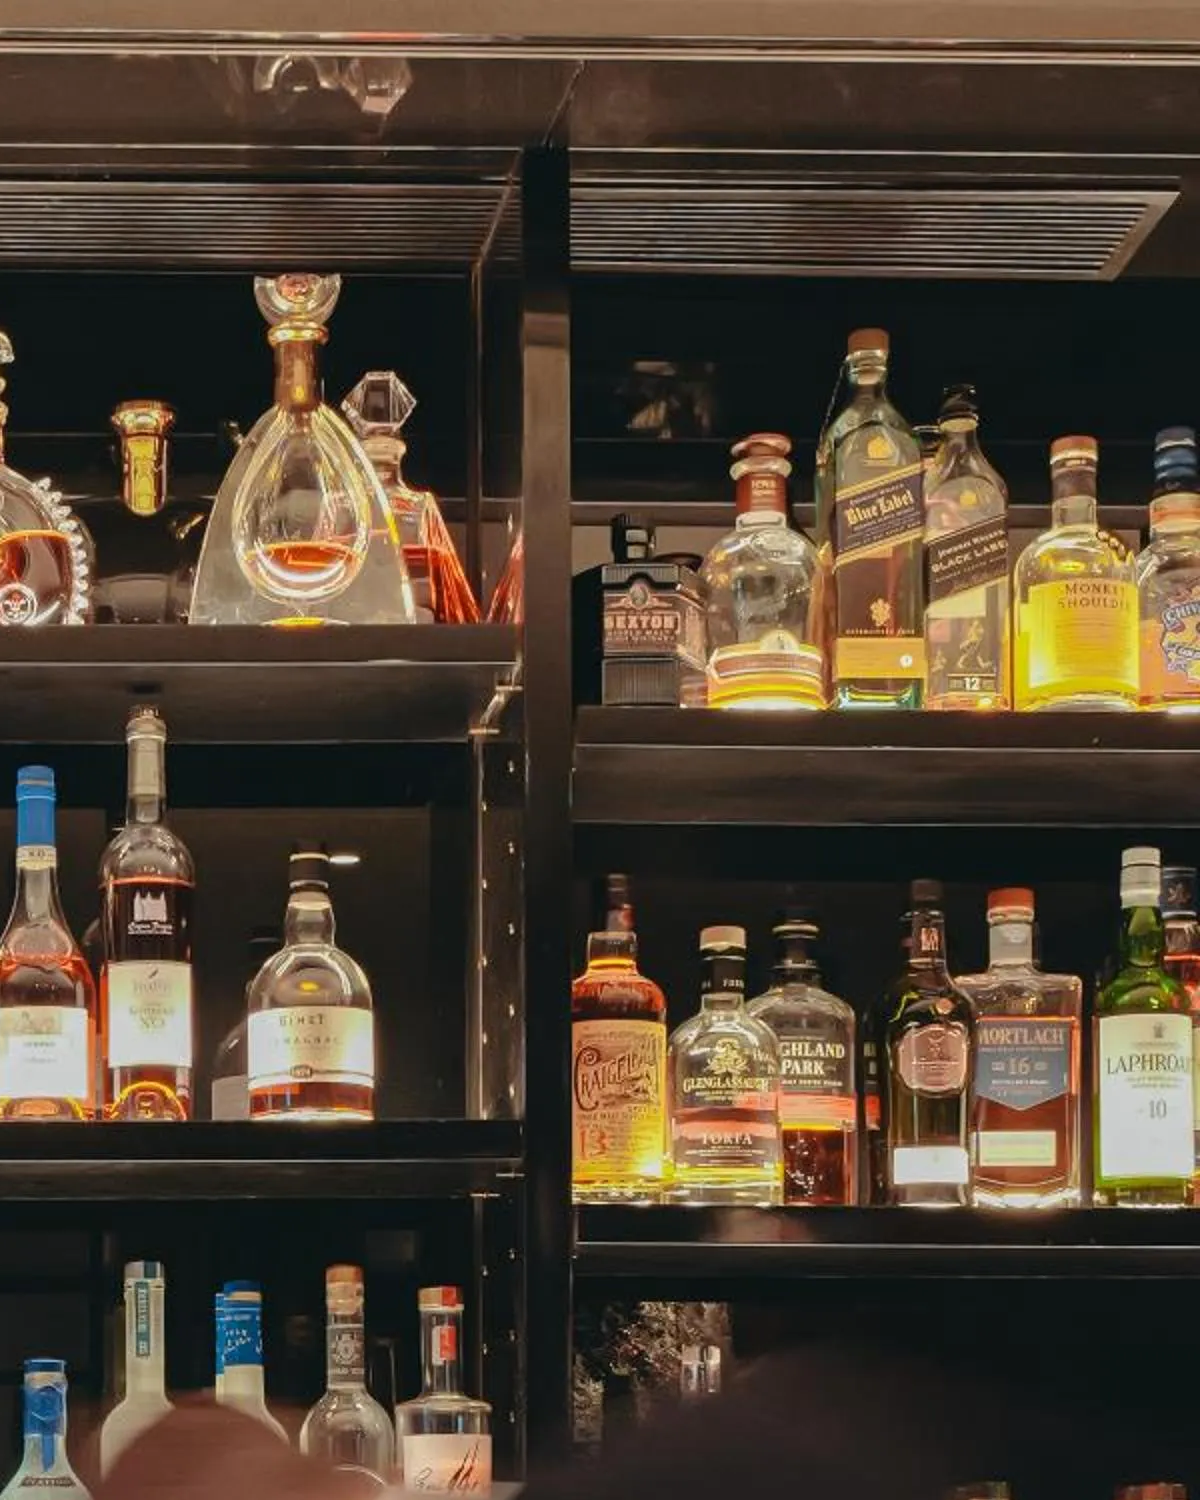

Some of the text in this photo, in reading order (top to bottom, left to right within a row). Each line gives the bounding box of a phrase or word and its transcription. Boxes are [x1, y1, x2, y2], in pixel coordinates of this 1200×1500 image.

[846, 504, 878, 525] Blue
[879, 490, 915, 517] Label
[931, 552, 972, 574] BLACK
[964, 677, 980, 691] 12
[779, 1041, 846, 1060] GHLAND
[780, 1059, 825, 1076] PARK
[1008, 1057, 1031, 1075] 16
[1149, 1100, 1168, 1120] 10
